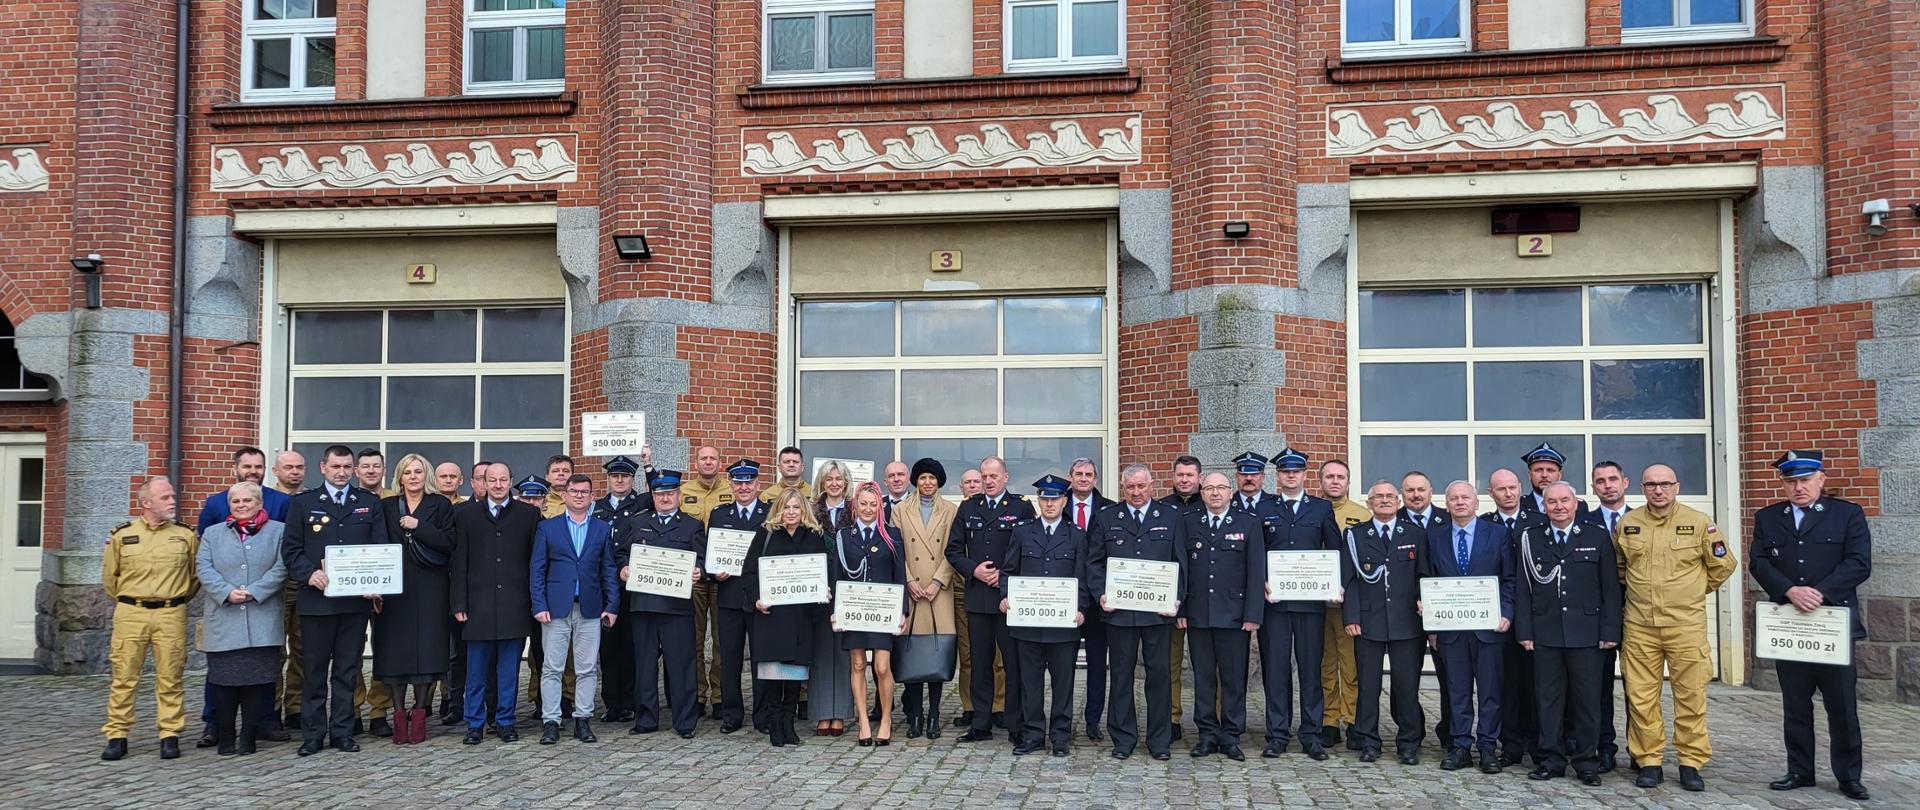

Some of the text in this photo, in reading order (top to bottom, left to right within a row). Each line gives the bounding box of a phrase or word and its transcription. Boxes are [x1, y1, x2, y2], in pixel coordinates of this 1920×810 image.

[1529, 237, 1543, 253] 2
[940, 252, 953, 268] 3
[413, 265, 426, 280] 4
[592, 439, 609, 447] 950
[611, 438, 627, 447] 000
[716, 556, 745, 567] 950 00
[337, 576, 391, 586] 950 000 zł
[637, 574, 654, 584] 950
[656, 576, 673, 586] 000
[1279, 581, 1297, 590] 950
[1300, 581, 1318, 590] 000
[770, 586, 788, 595] 950
[790, 585, 808, 594] 000
[1116, 589, 1167, 602] 950 000 zł
[845, 611, 862, 621] 950
[864, 613, 881, 622] 000
[1018, 607, 1036, 617] 950
[1038, 608, 1056, 617] 000
[1434, 609, 1489, 619] 400 000 zł
[1770, 637, 1835, 652] 950 000 zł
